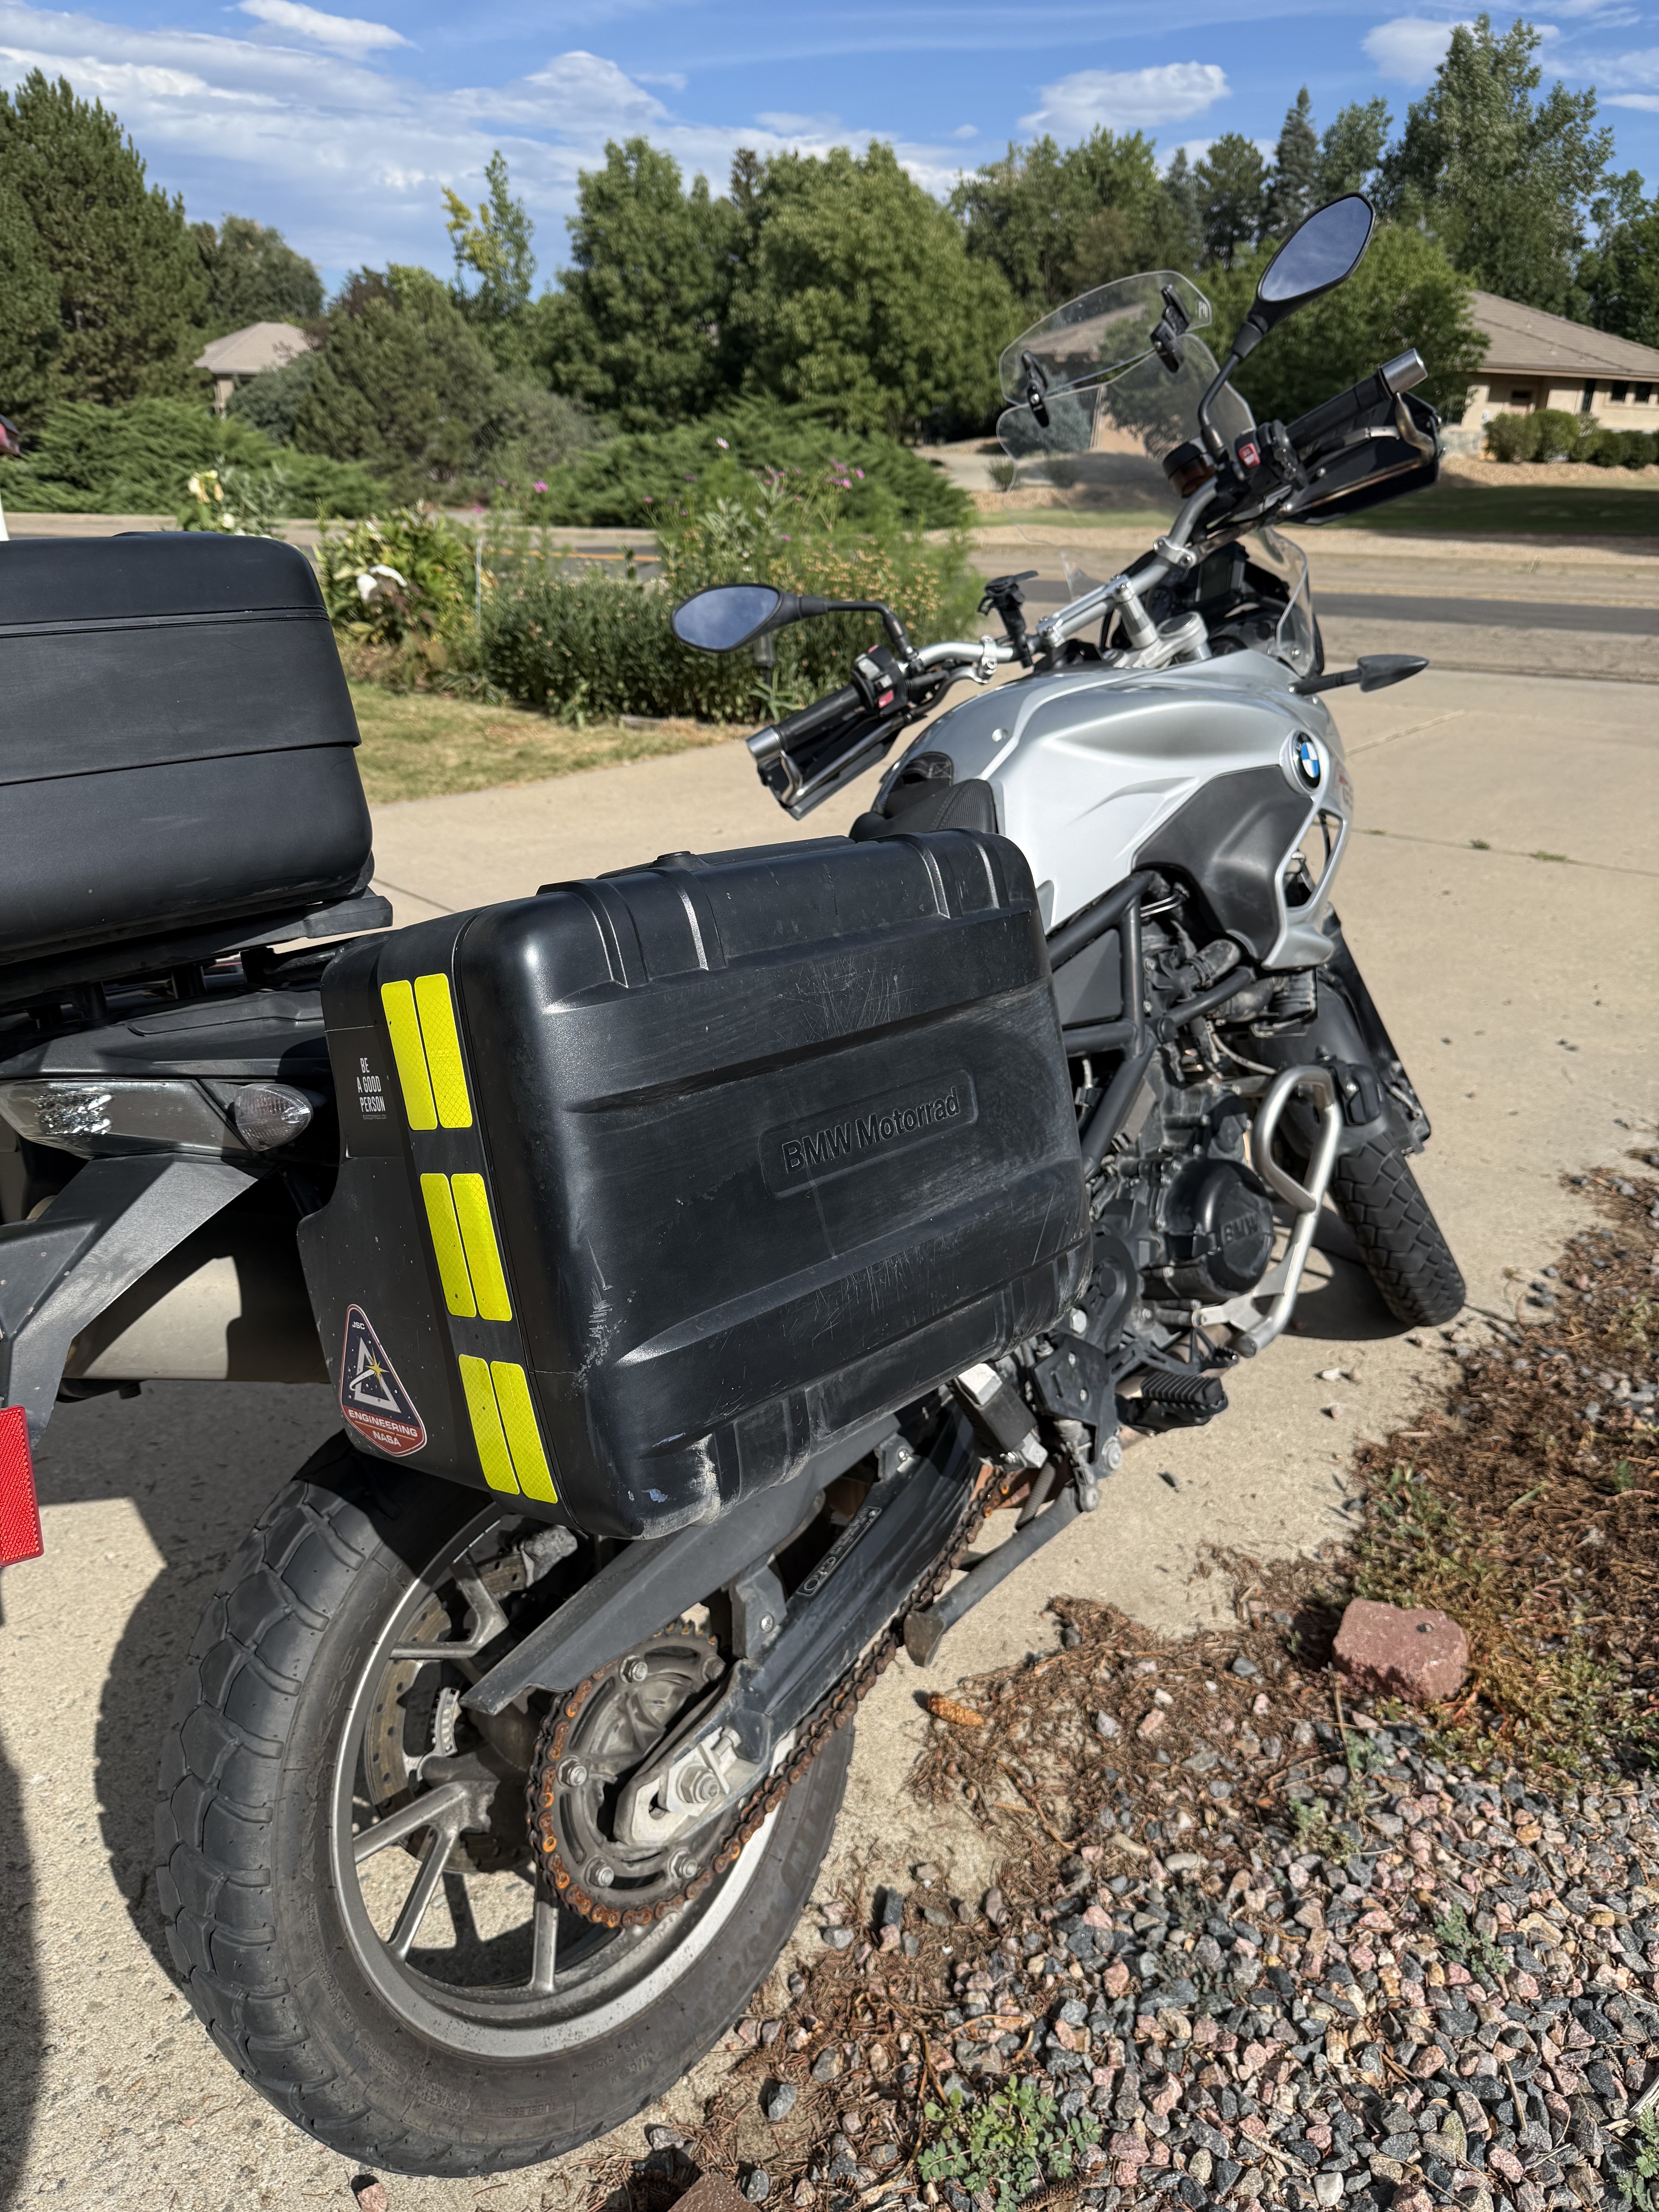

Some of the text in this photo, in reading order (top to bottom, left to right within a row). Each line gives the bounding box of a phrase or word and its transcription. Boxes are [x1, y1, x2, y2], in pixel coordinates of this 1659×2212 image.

[360, 1058, 370, 1073] BE
[357, 1076, 381, 1093] A GOOD
[359, 1096, 386, 1112] PERSON
[782, 1086, 960, 1174] BMW Motorrad
[352, 1321, 365, 1330] JSC
[349, 1409, 418, 1437] ENGINEERING
[373, 1431, 401, 1447] NASA
